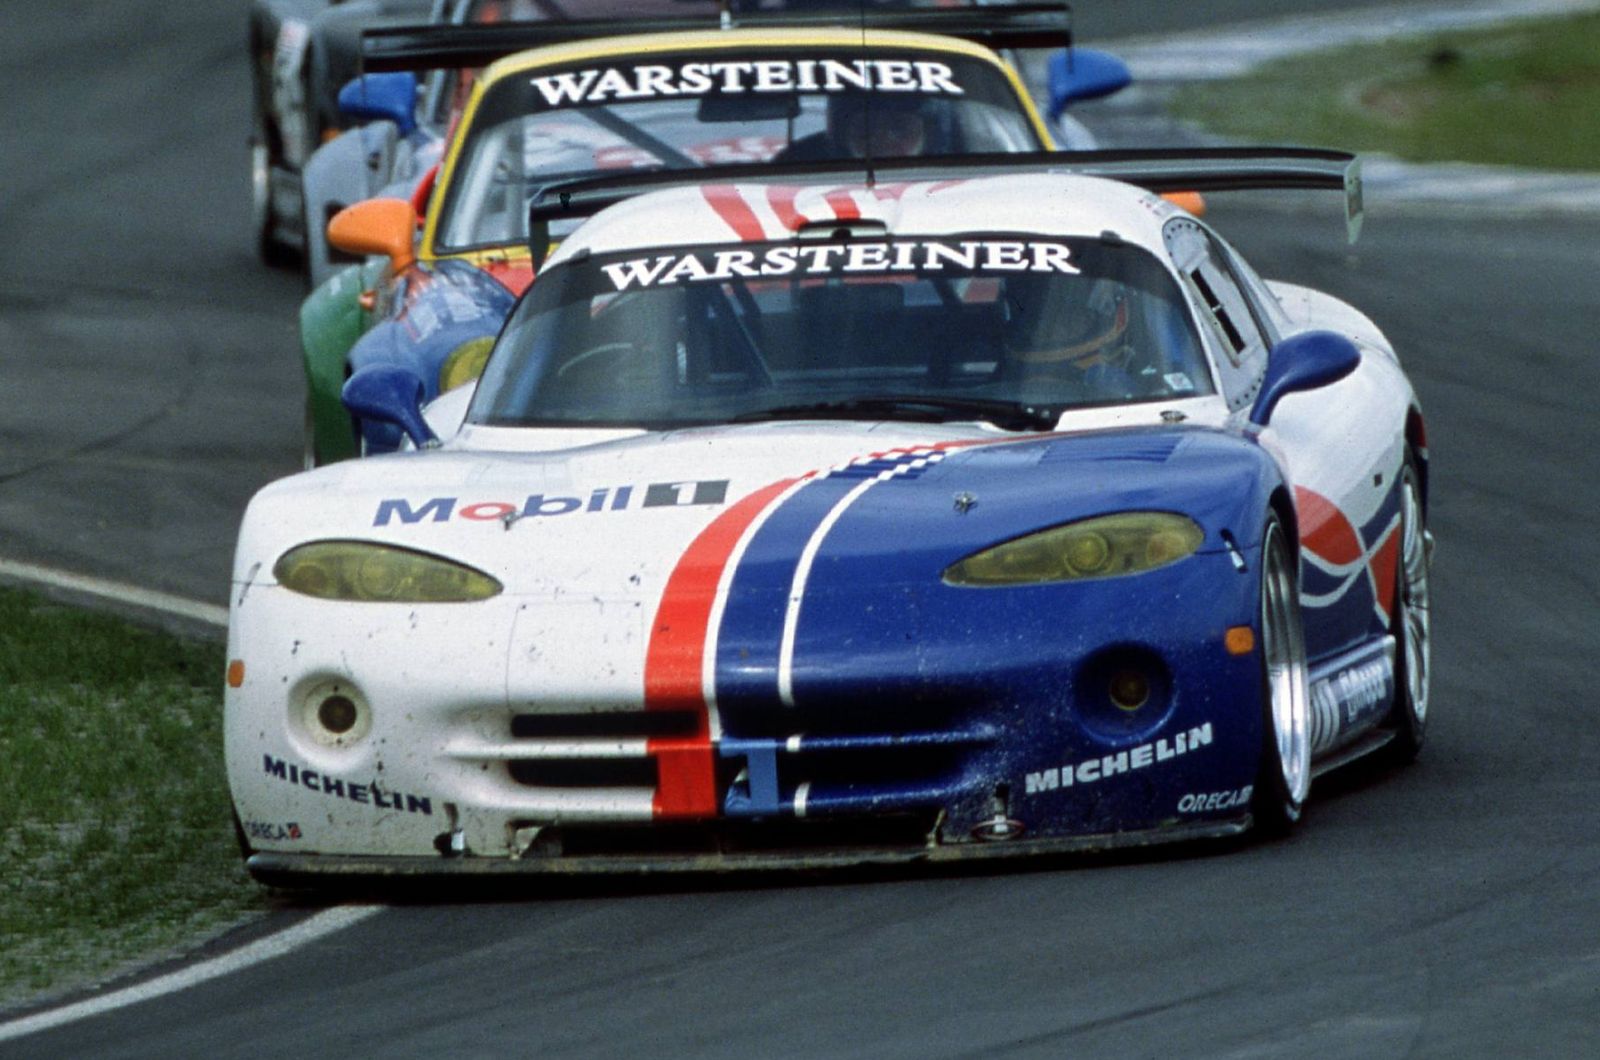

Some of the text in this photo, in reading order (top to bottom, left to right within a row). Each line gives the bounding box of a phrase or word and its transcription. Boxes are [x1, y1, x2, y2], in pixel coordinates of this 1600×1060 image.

[531, 59, 965, 106] WARSTEINER
[601, 241, 1081, 291] WARSTEINER
[372, 484, 634, 527] Mobil
[1024, 721, 1214, 794] MICHELIN
[263, 753, 432, 816] MICHELIN
